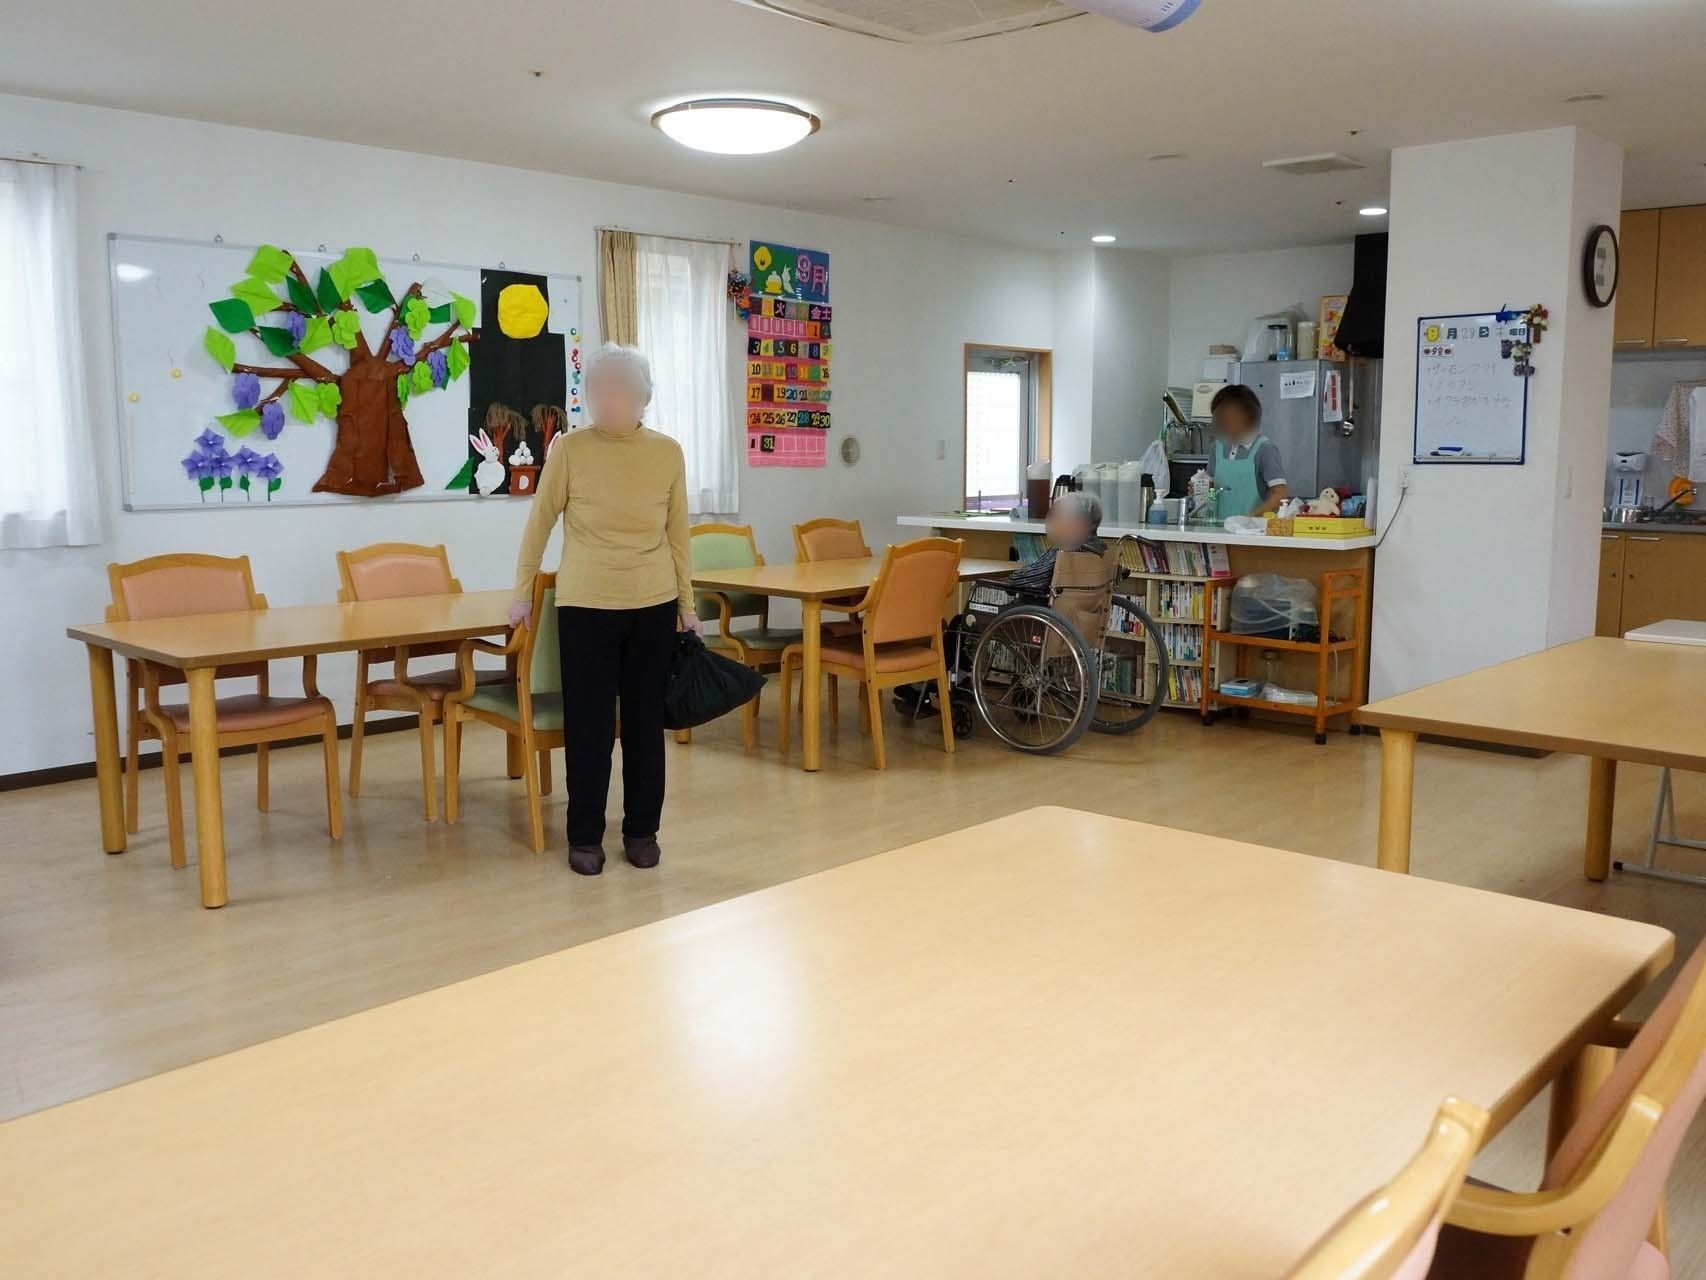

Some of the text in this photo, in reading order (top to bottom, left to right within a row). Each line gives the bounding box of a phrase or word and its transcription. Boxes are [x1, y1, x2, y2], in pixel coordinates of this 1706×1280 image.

[797, 254, 826, 296] 9月
[775, 302, 785, 316] 火
[810, 306, 821, 320] 金
[822, 308, 831, 320] 土
[822, 323, 830, 336] 2
[1447, 328, 1457, 340] 月
[753, 340, 760, 354] 3
[778, 341, 784, 354] 5
[790, 344, 797, 354] 6
[812, 345, 819, 357] 8
[752, 364, 760, 374] 10
[822, 368, 830, 378] 16
[752, 388, 760, 400] 17
[776, 388, 786, 398] 19
[786, 389, 797, 400] 20
[799, 390, 808, 400] 21
[750, 412, 830, 426] 24 25 26 27 28 29 30
[764, 438, 774, 450] 31
